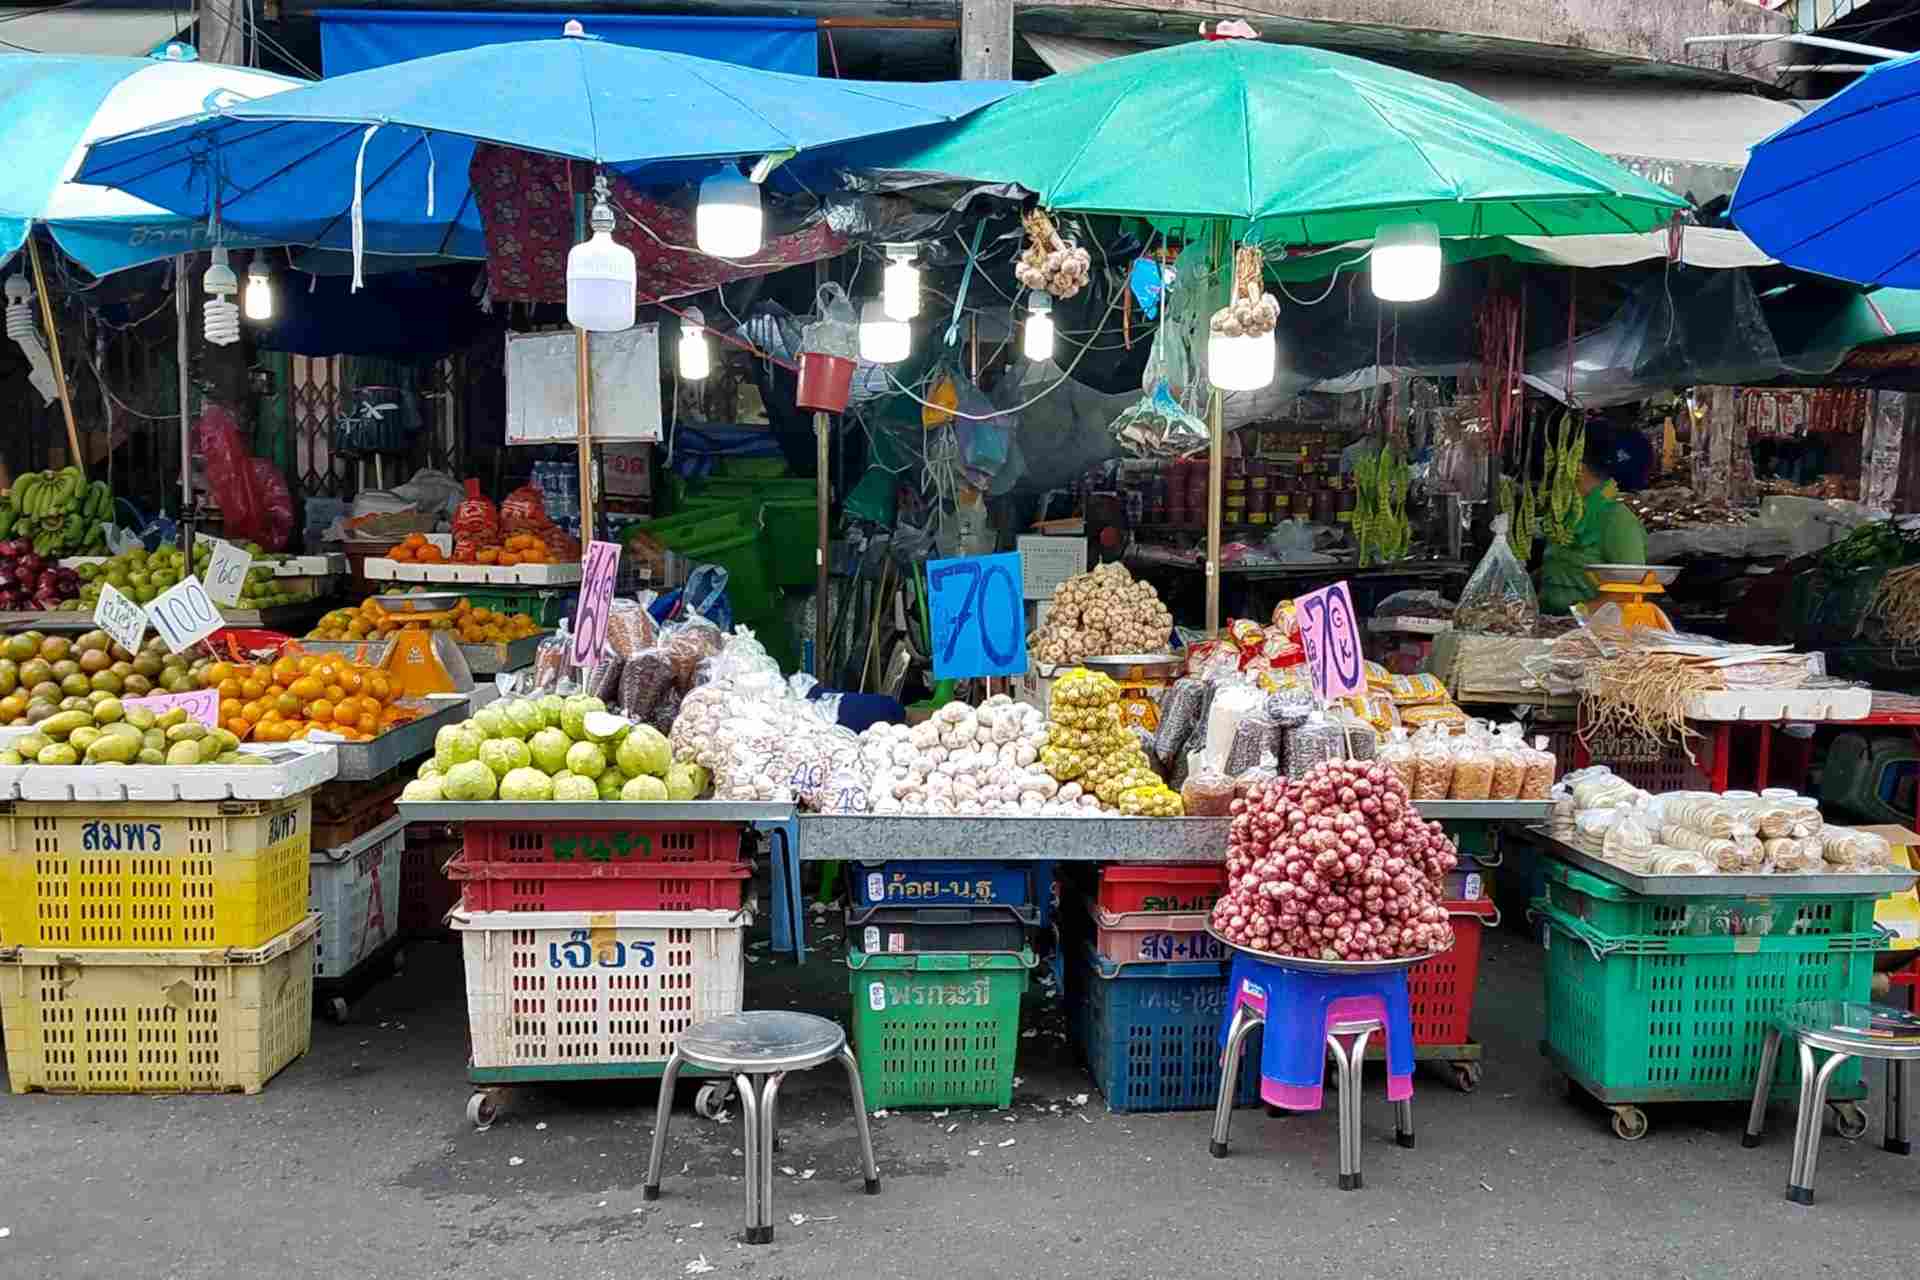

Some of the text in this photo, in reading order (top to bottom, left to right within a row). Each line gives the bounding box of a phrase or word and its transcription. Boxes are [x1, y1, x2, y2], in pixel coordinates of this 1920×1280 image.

[154, 584, 212, 645] 100
[931, 561, 1019, 667] 70
[1303, 586, 1359, 698] 70
[82, 820, 162, 851] สมพร
